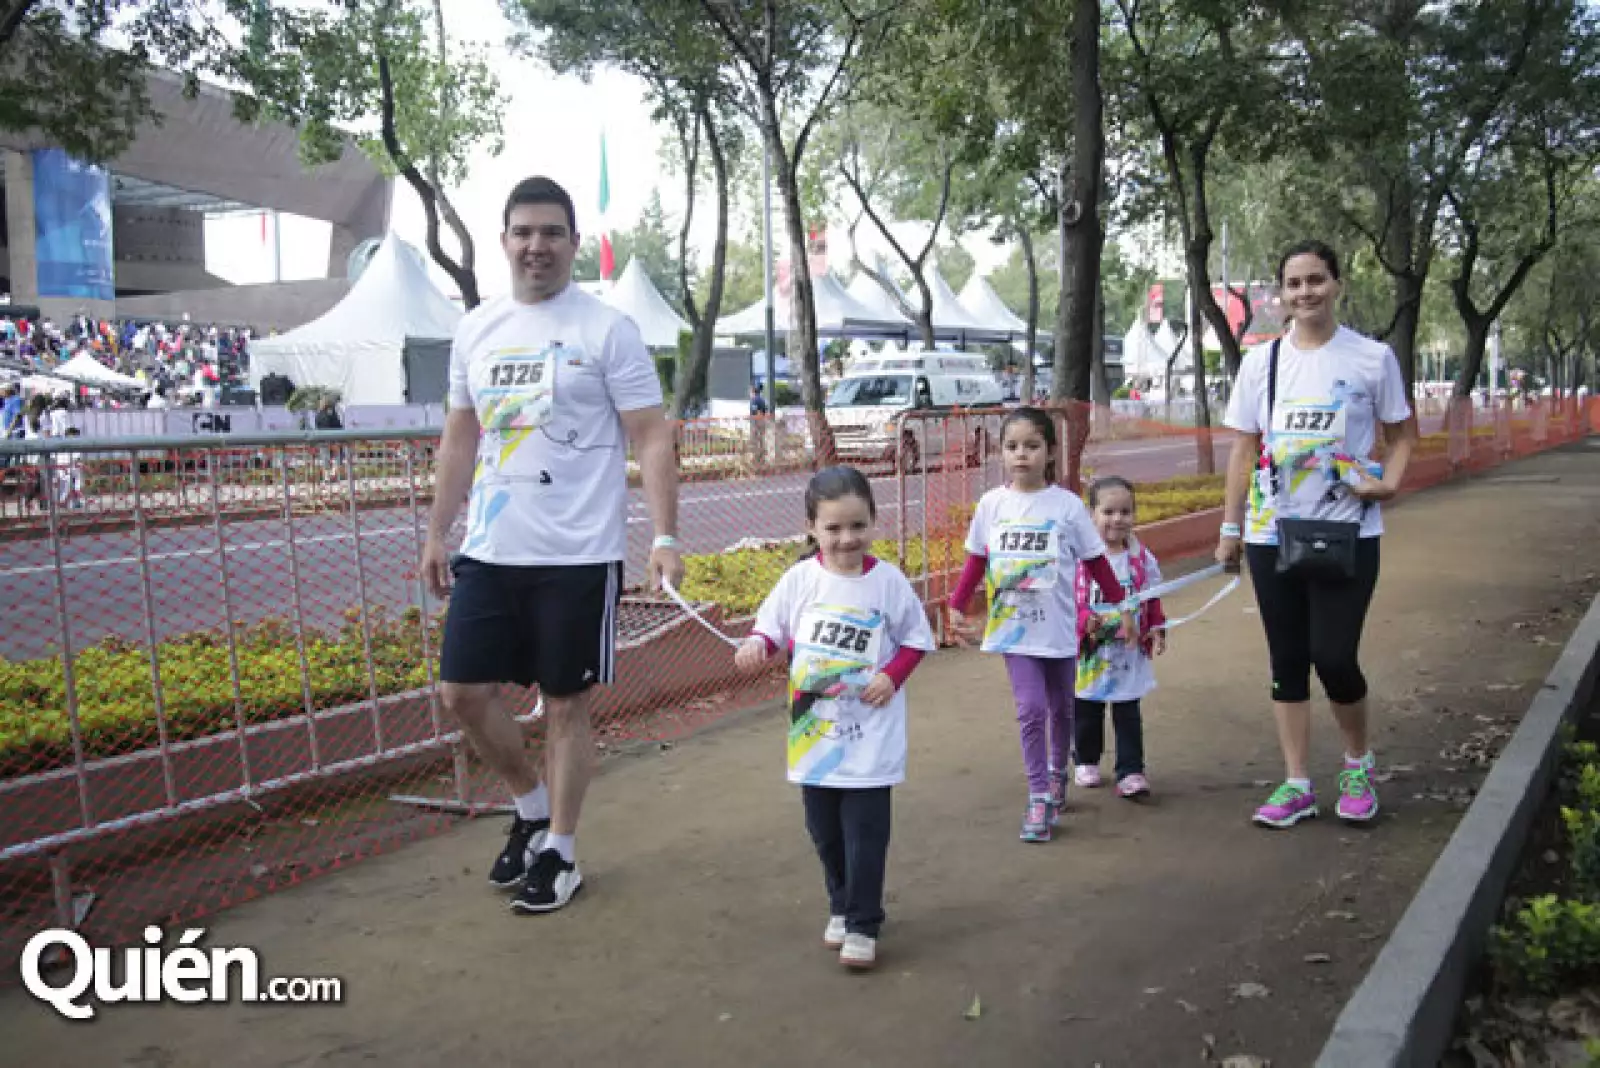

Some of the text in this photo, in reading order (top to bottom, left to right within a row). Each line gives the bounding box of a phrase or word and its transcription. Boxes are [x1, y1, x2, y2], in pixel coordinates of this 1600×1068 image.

[490, 362, 544, 386] 1326
[1284, 410, 1336, 431] 1327
[1000, 531, 1050, 551] 1325
[810, 620, 872, 653] 1326
